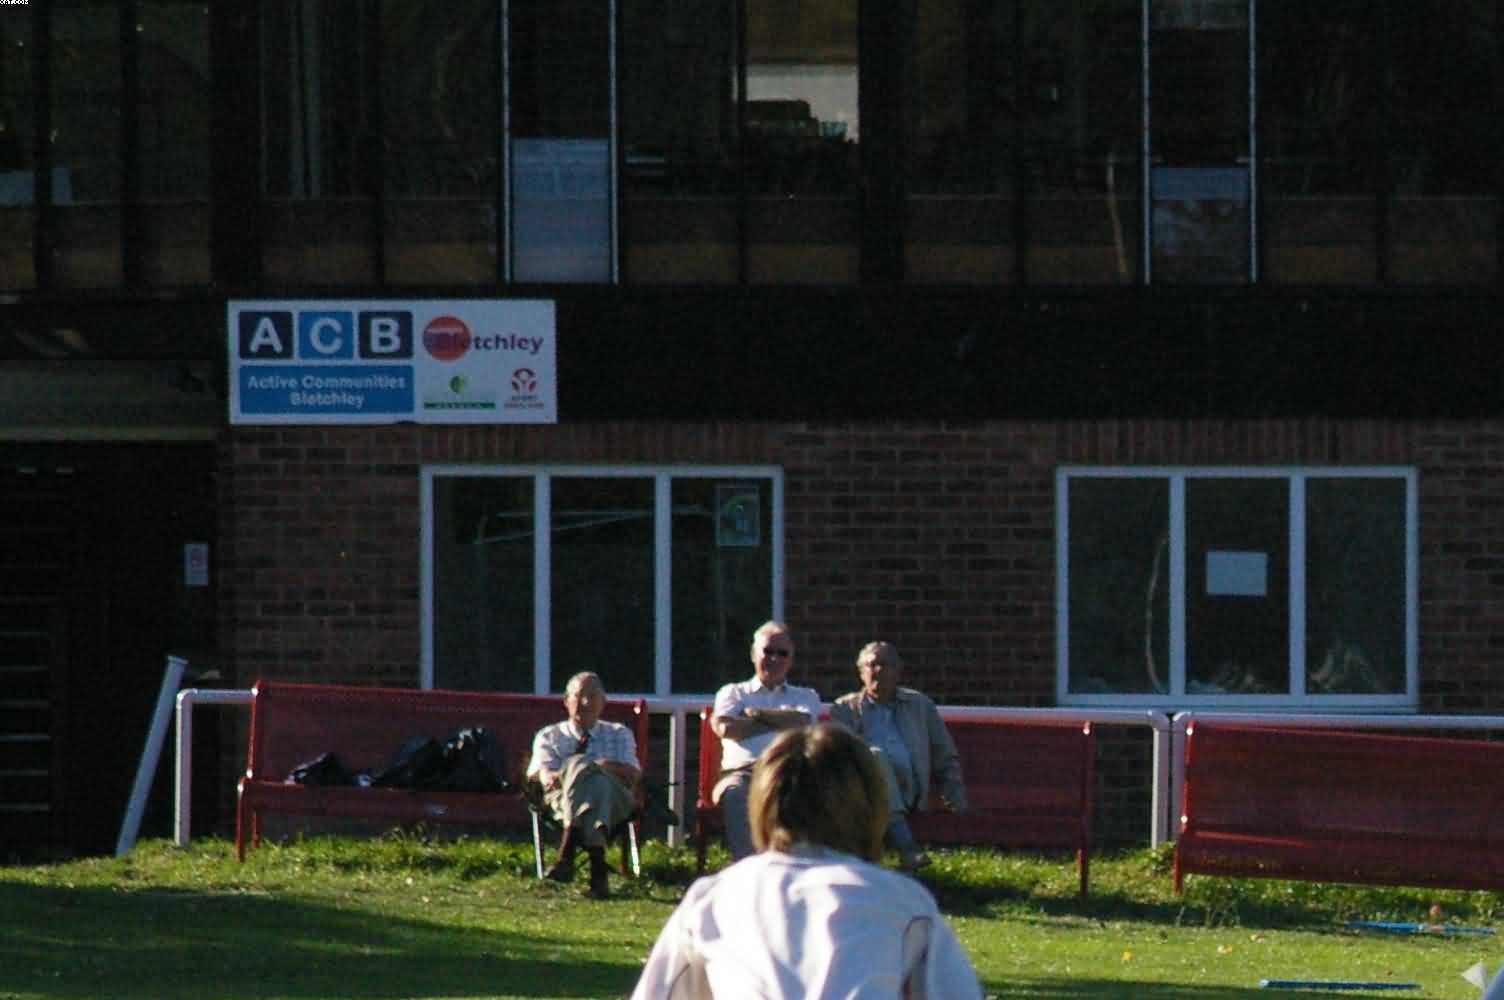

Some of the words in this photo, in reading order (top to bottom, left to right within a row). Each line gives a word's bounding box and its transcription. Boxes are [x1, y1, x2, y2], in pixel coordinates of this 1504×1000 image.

[248, 375, 298, 390] Active
[301, 374, 405, 390] Communities
[289, 391, 365, 409] Bletchley
